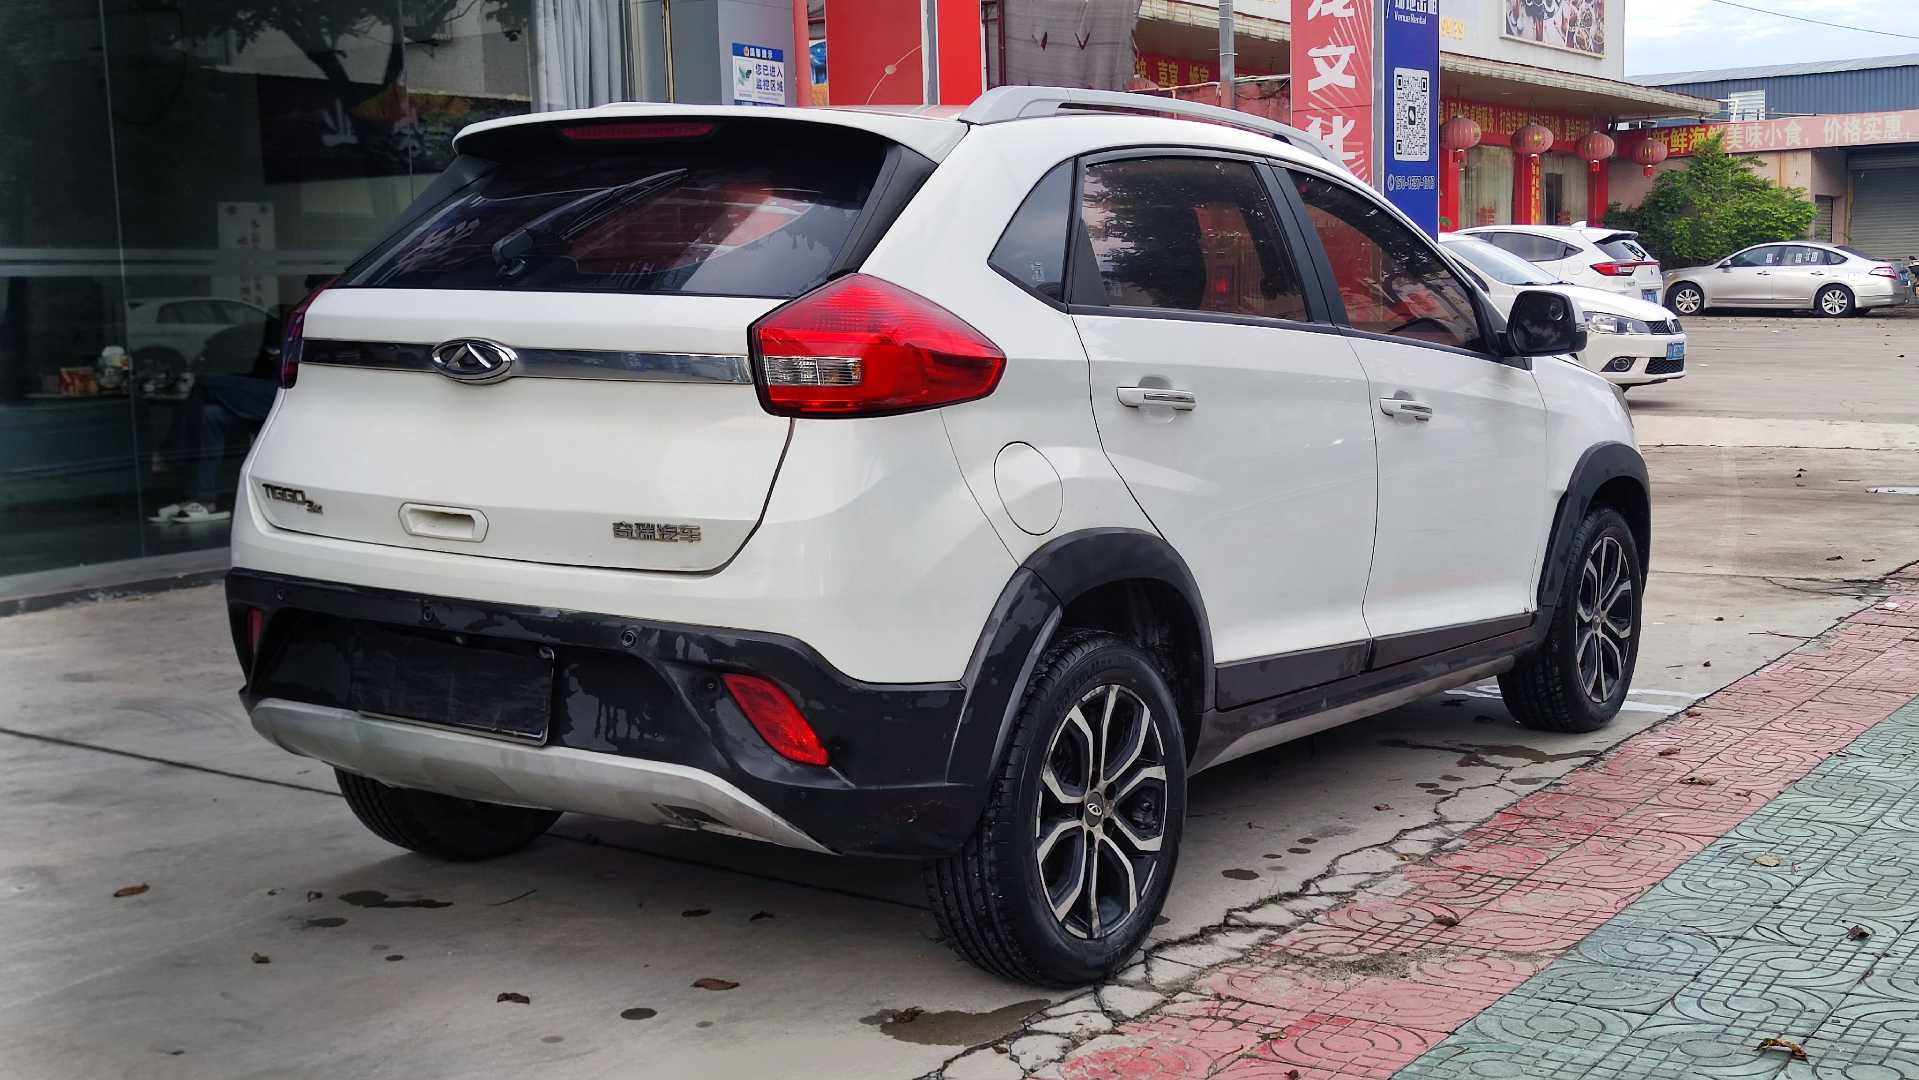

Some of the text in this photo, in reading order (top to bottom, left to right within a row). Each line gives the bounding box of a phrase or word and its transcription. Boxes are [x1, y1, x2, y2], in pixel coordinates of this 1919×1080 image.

[1394, 10, 1427, 25] Venue Rental
[755, 63, 783, 78] 您已进入
[755, 79, 784, 93] 监控区域
[612, 520, 702, 544] 奇瑞汽车
